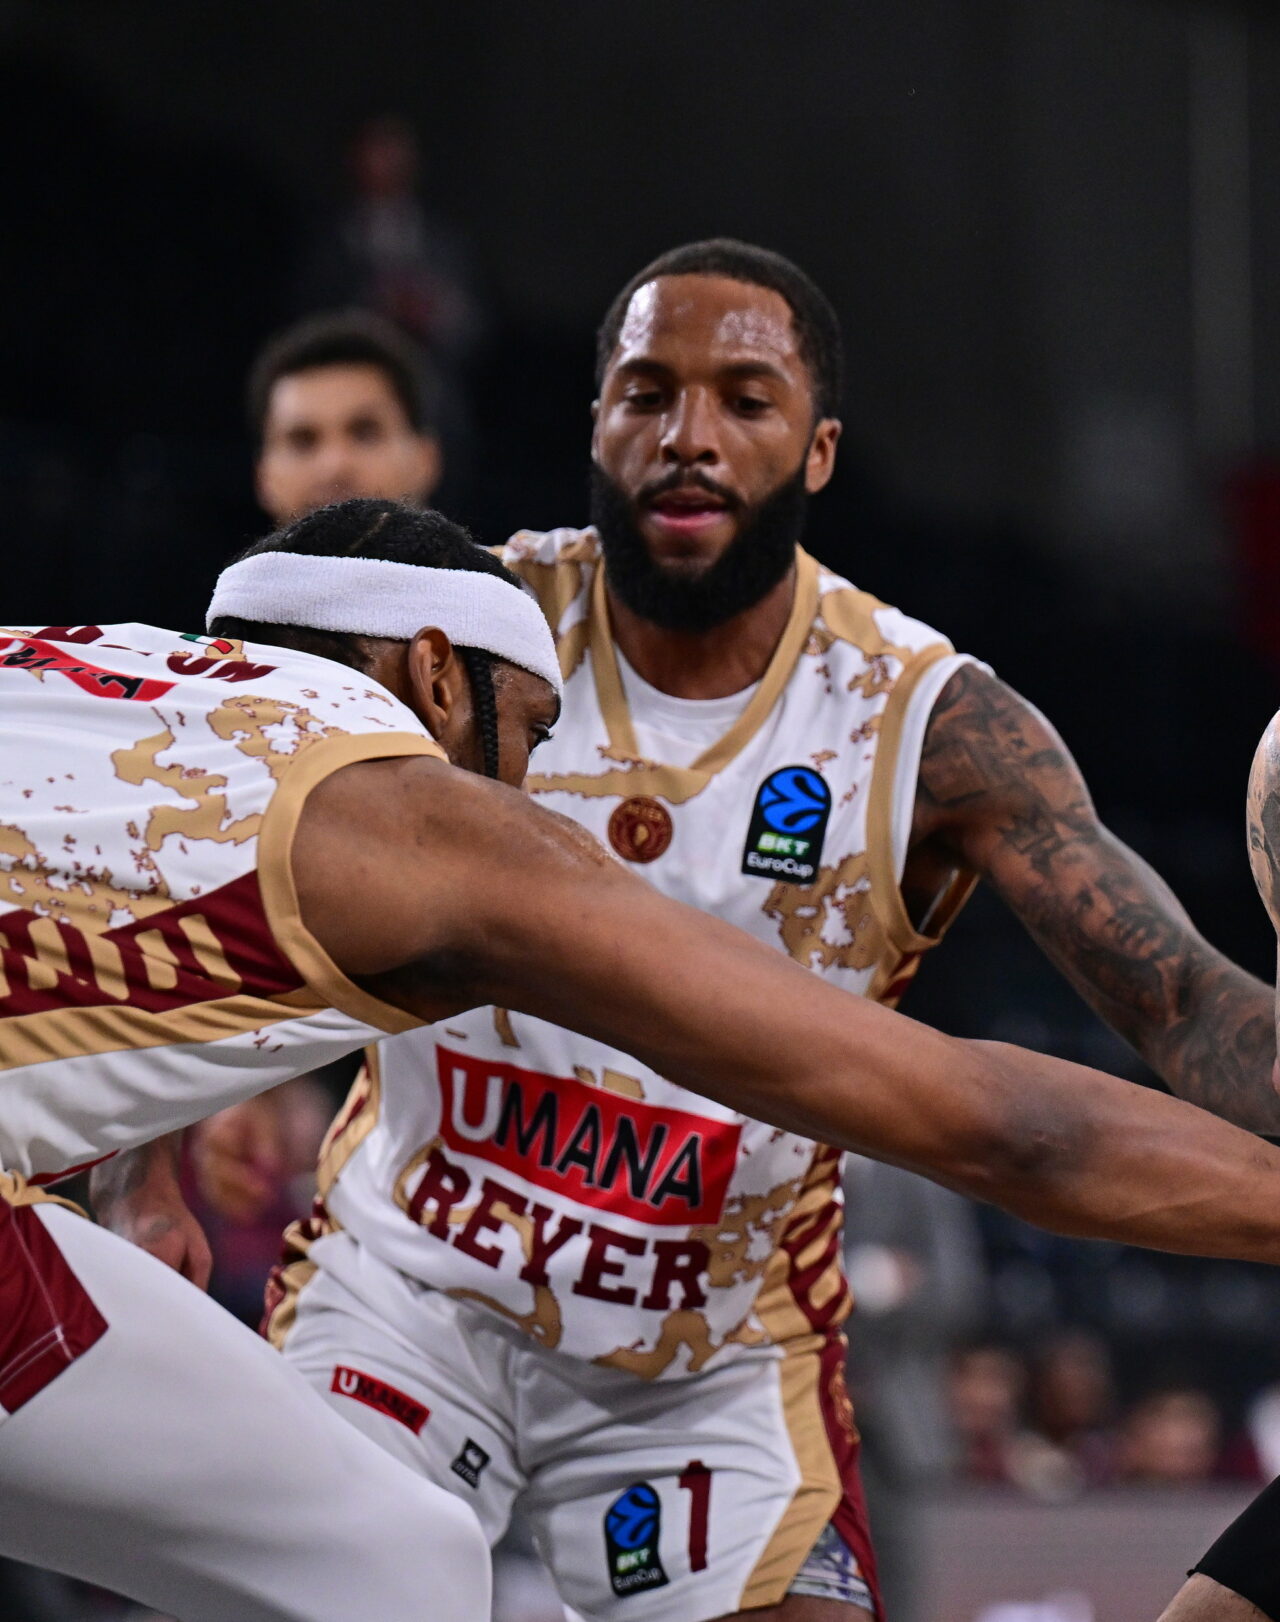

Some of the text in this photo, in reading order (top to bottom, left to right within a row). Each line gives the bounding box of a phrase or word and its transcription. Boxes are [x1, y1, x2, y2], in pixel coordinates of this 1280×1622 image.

[746, 852, 814, 878] EuroCup
[758, 833, 810, 856] BKT
[451, 1067, 703, 1210] UMANA
[409, 1148, 711, 1311] REYER
[679, 1460, 712, 1572] 1
